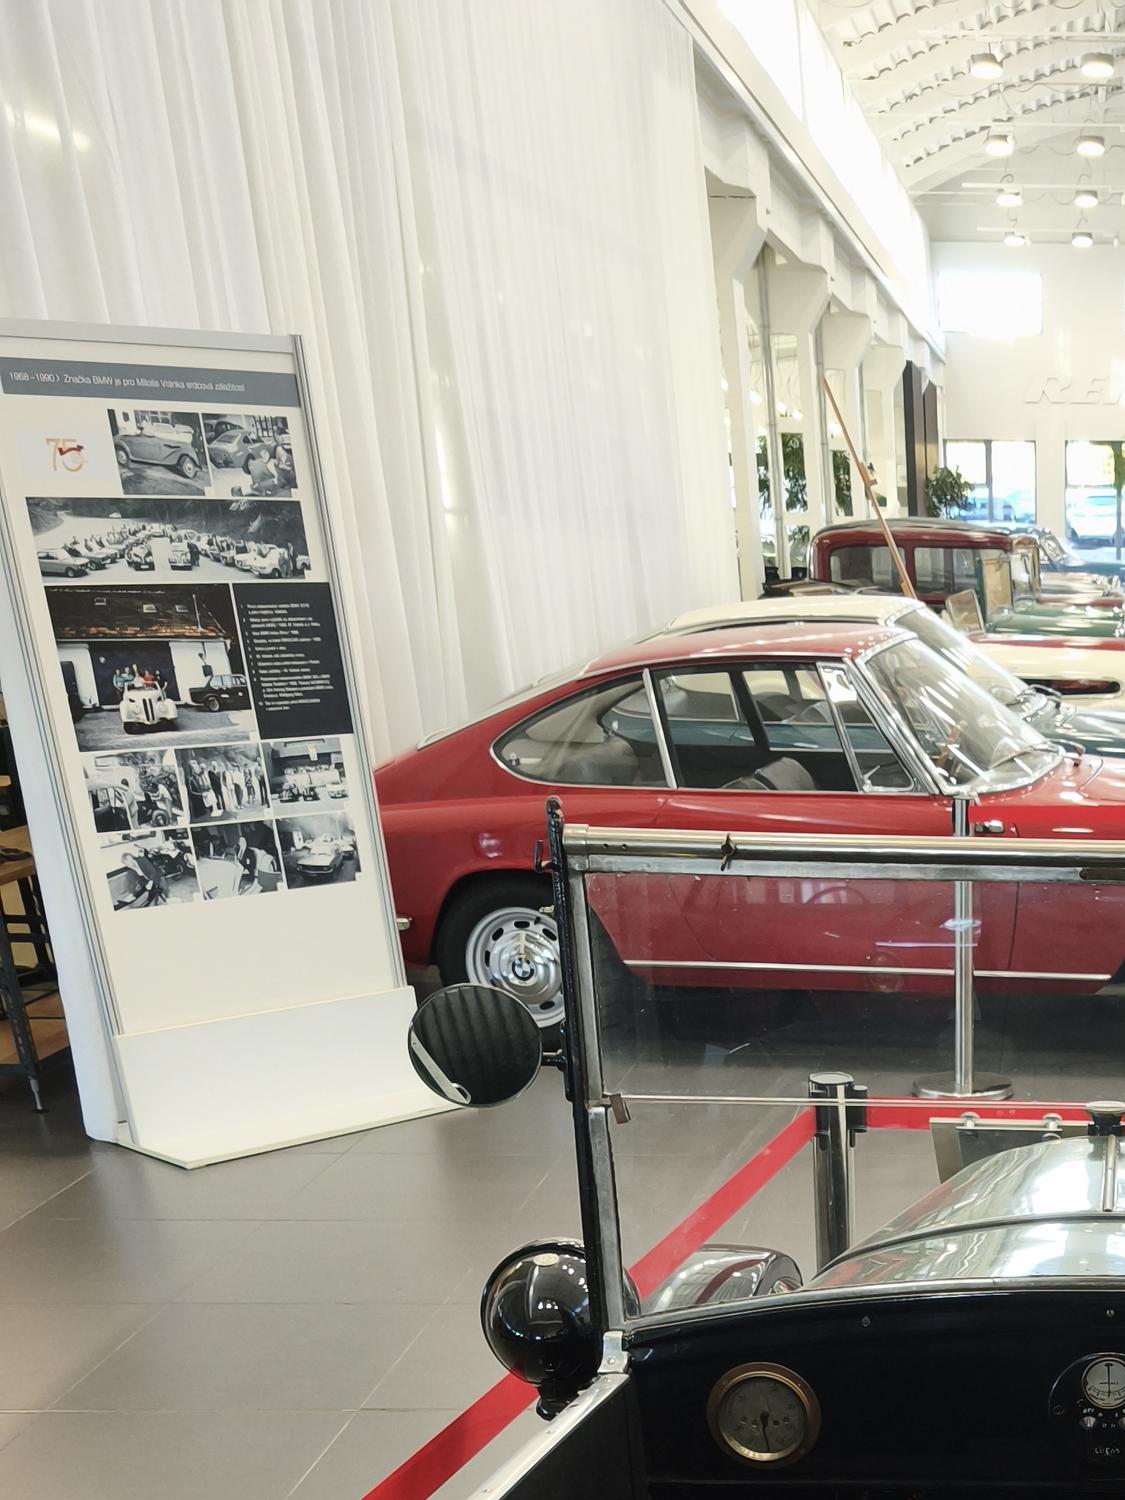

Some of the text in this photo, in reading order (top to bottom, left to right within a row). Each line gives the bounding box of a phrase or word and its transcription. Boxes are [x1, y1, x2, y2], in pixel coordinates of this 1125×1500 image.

[63, 373, 91, 384] Značka
[92, 375, 113, 385] BMW
[123, 378, 136, 388] pro
